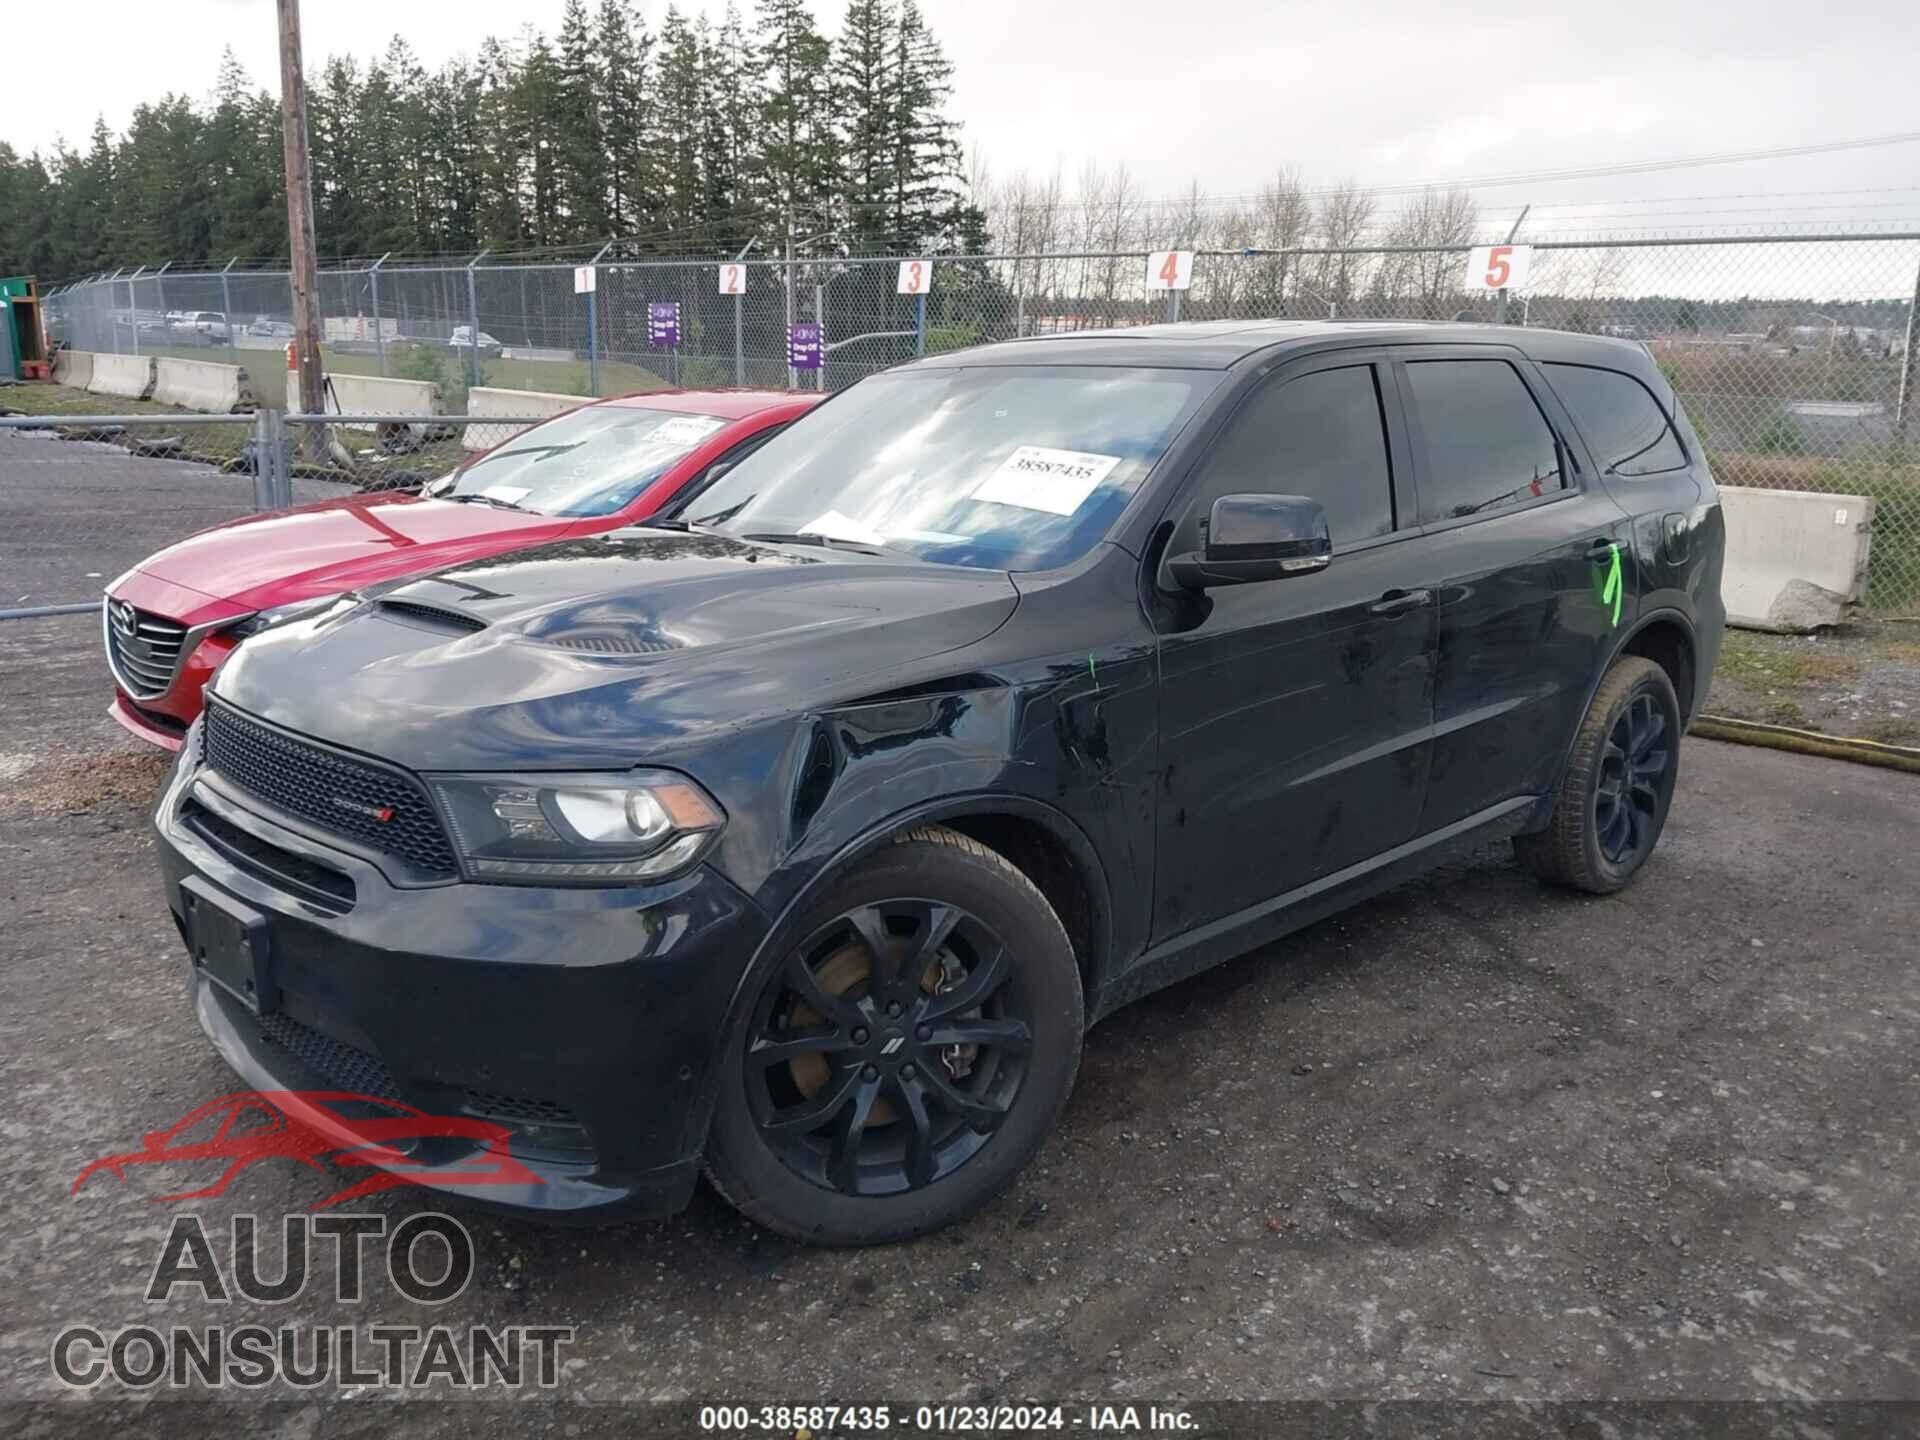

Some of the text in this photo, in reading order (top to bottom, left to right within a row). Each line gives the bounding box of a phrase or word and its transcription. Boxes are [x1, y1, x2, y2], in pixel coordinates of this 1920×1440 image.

[726, 266, 739, 293] 2
[907, 263, 922, 293] 3
[1159, 253, 1178, 287] 4
[1485, 246, 1514, 288] 5
[1016, 459, 1095, 479] 38587435
